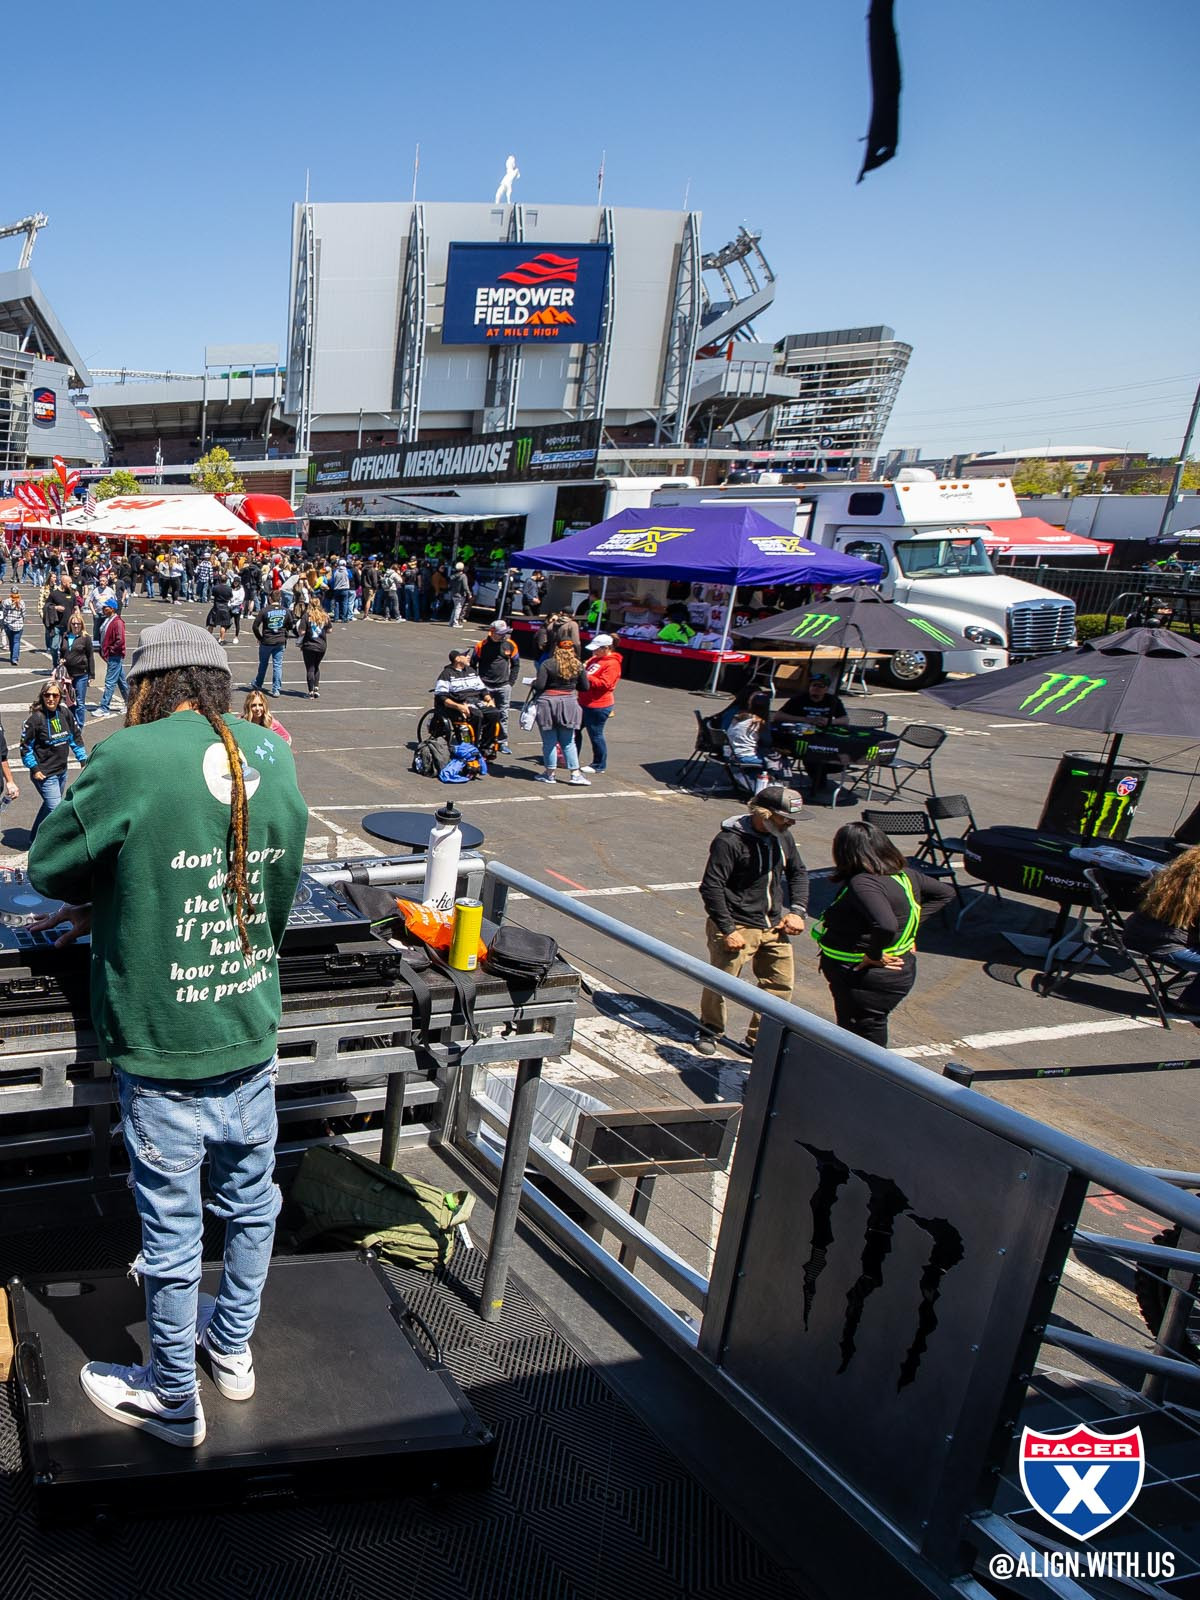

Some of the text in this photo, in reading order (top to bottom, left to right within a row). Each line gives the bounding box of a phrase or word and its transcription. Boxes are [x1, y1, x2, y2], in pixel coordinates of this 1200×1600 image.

[476, 288, 575, 306] EMPOWER
[474, 307, 529, 325] FIELD
[486, 328, 559, 336] AT MILE HIGH
[351, 441, 513, 482] OFFICIAL MERCHANDISE
[530, 449, 597, 464] SUPERCROSS
[171, 847, 223, 869] don't
[184, 895, 219, 914] the
[175, 917, 197, 942] if
[200, 916, 234, 940] you
[170, 962, 215, 981] how
[220, 960, 240, 975] to
[175, 985, 209, 1003] the
